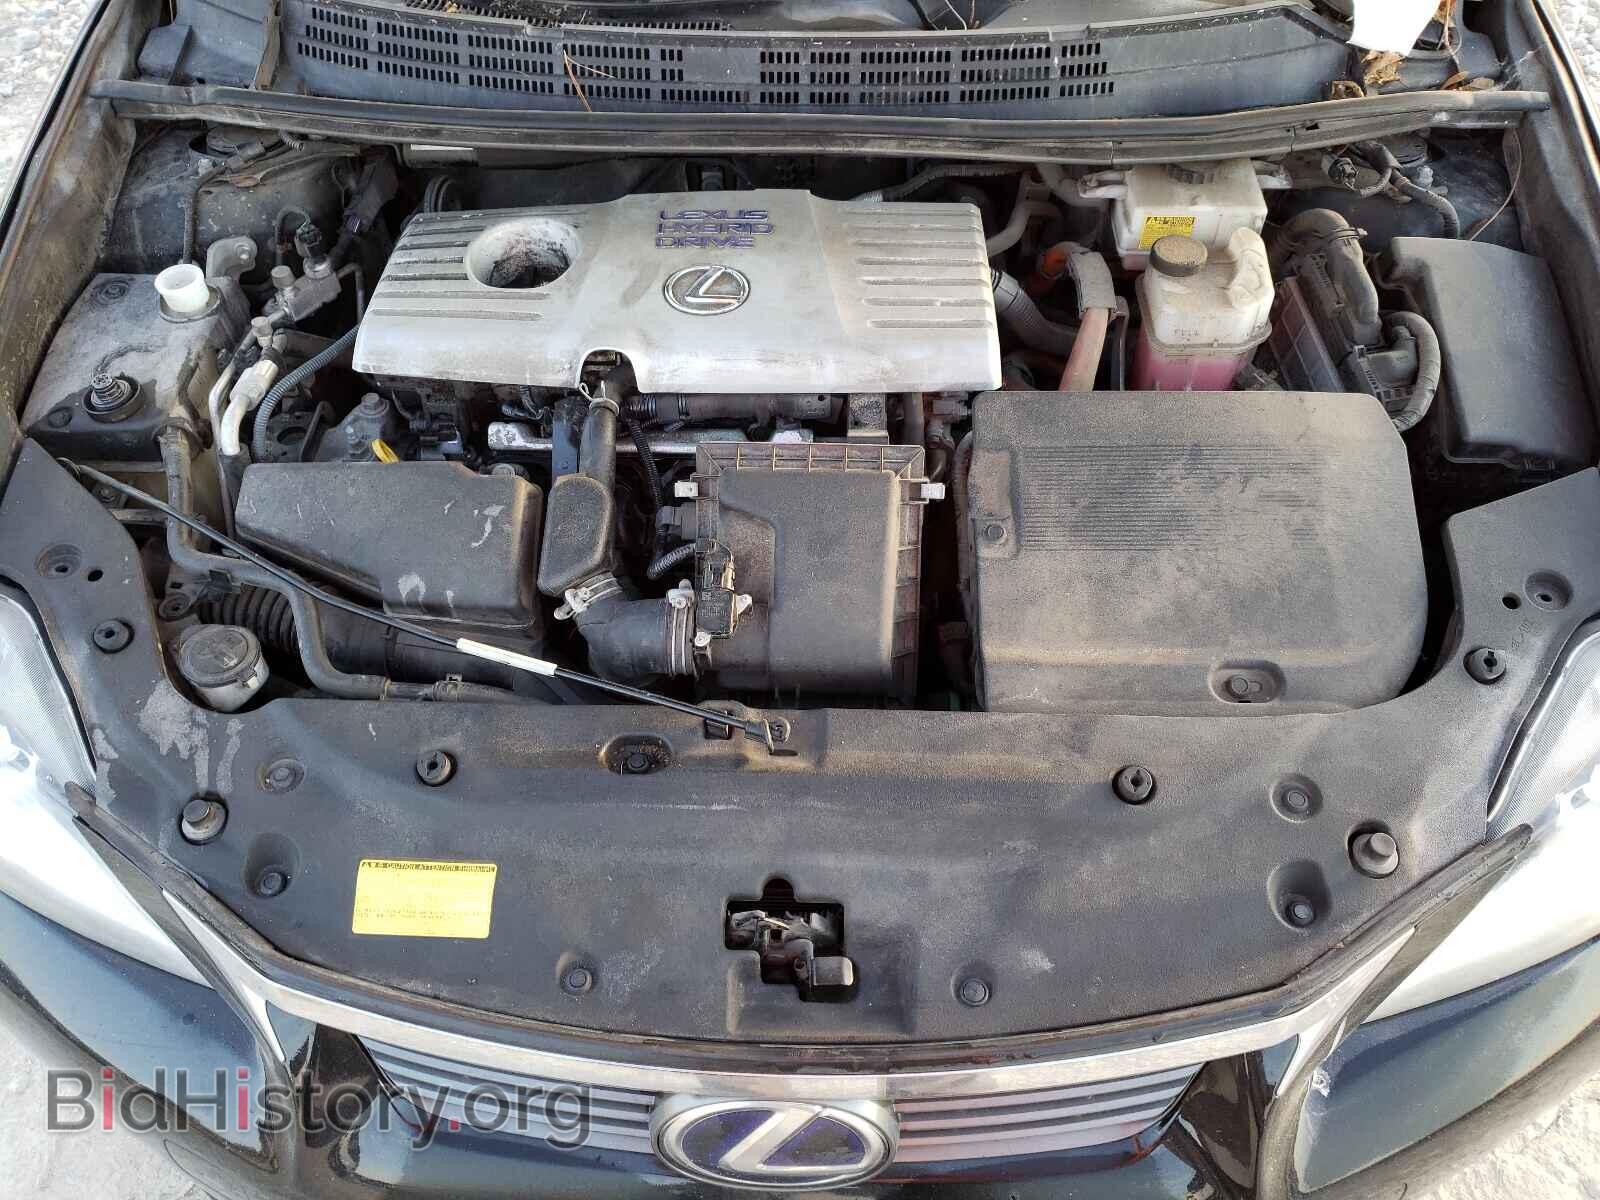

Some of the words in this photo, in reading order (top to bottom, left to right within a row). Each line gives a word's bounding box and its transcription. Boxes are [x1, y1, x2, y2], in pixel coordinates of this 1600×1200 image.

[659, 209, 769, 222] LEXUS
[656, 223, 774, 235] HYBRID
[655, 236, 754, 249] DRIVE
